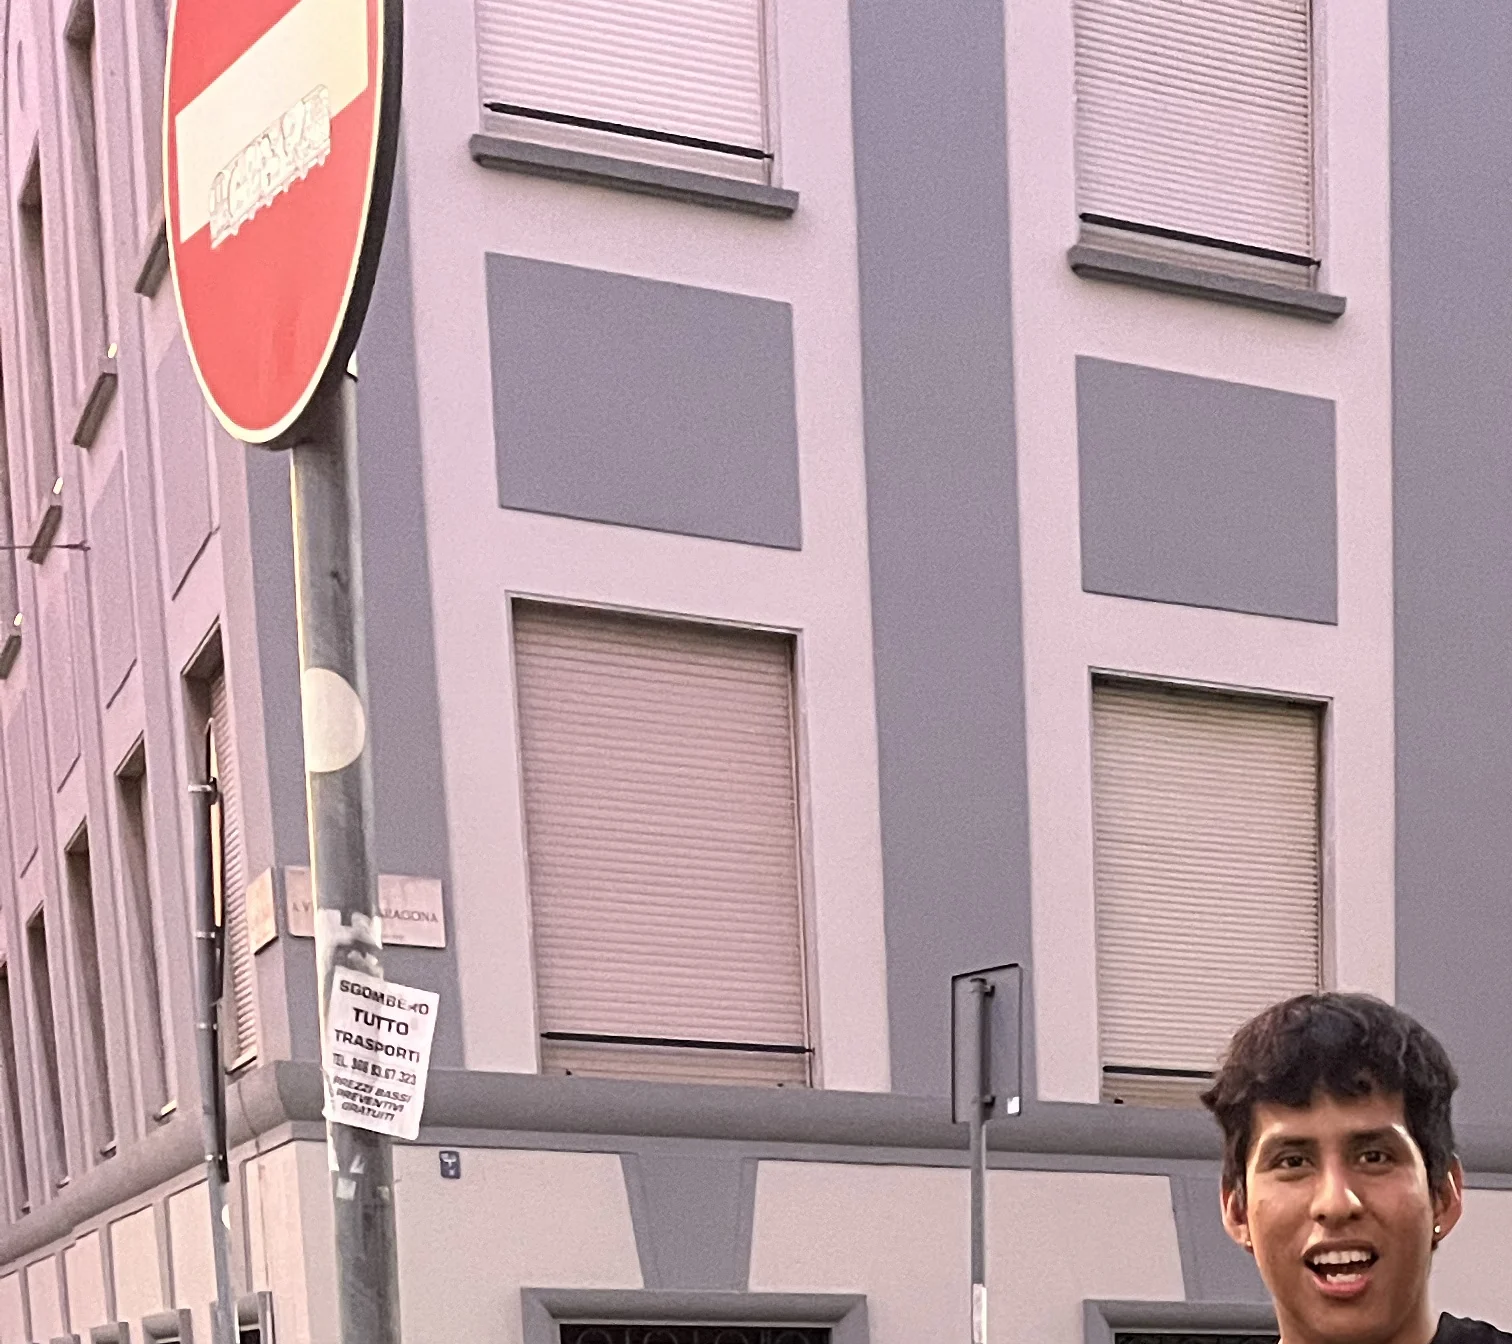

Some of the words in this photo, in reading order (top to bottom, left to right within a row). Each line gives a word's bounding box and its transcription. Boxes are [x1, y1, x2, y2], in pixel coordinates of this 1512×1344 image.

[353, 1006, 409, 1036] TUTTO
[334, 1028, 421, 1063] TRASPORTI
[374, 1087, 412, 1103] BASSI
